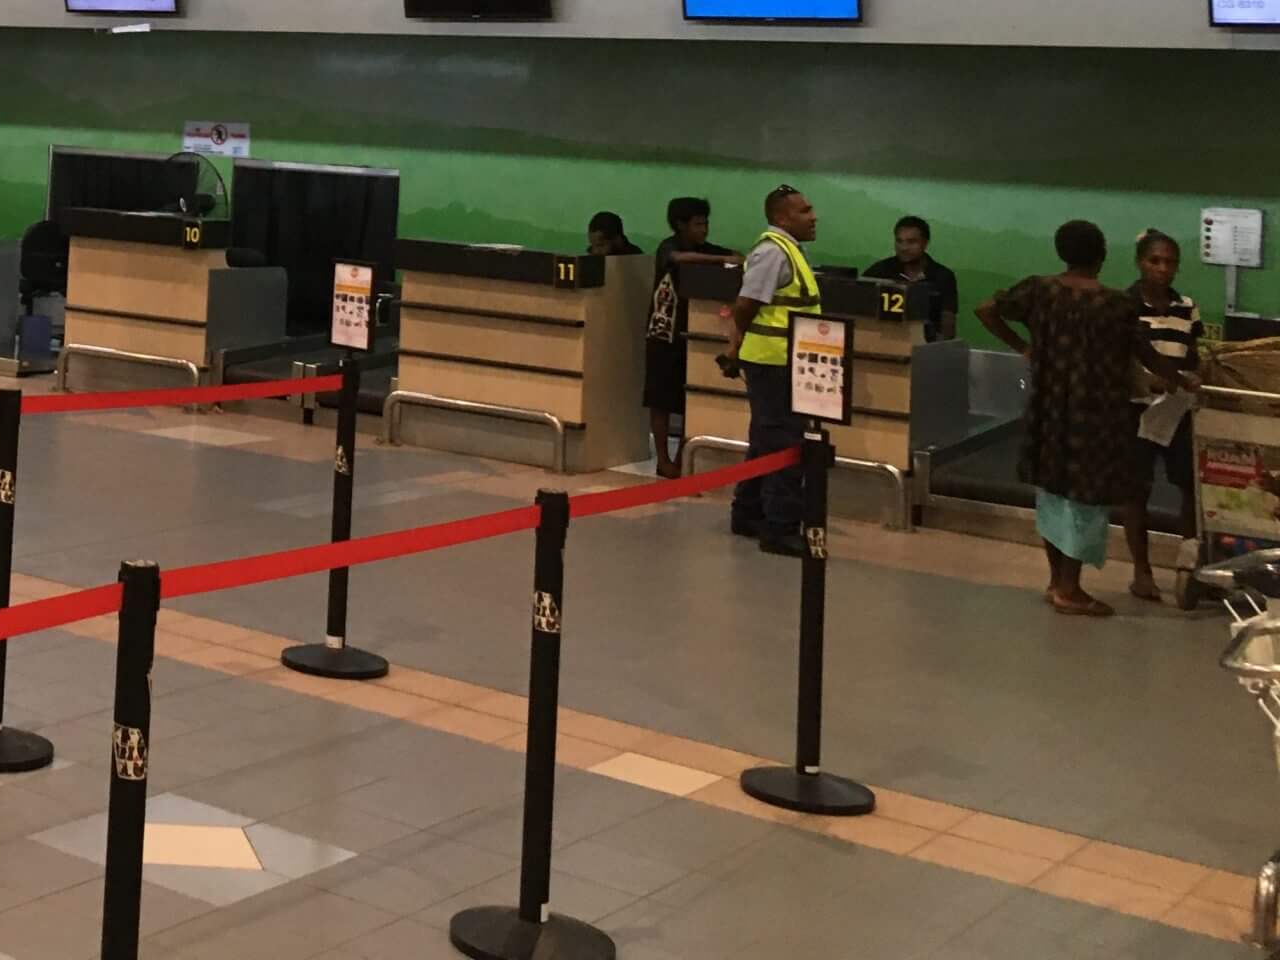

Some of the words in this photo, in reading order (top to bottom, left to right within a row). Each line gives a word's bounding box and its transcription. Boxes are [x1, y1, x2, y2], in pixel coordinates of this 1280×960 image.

[184, 227, 200, 243] 10
[558, 263, 574, 281] 11
[881, 292, 904, 313] 12
